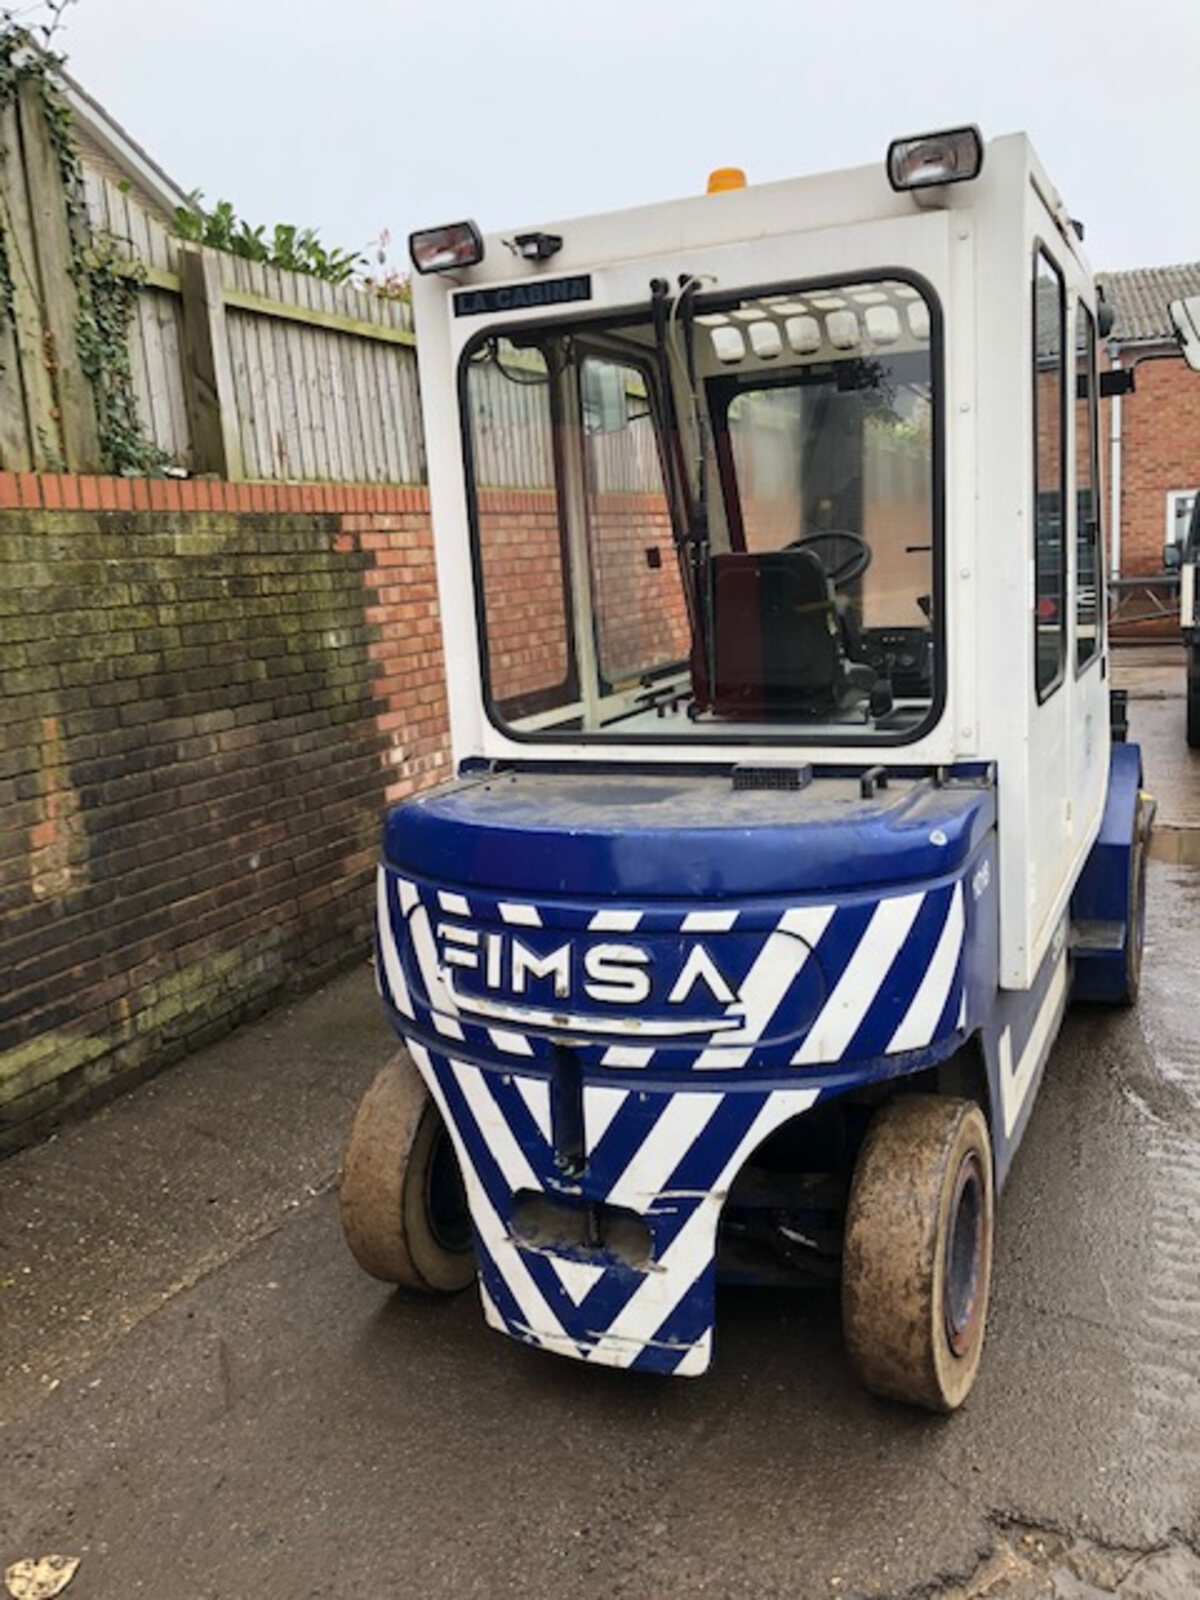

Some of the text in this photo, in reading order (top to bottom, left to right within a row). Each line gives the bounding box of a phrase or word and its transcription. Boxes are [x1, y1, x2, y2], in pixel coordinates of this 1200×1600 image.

[458, 279, 587, 313] LA CABINA
[437, 922, 736, 1004] FIMSA
